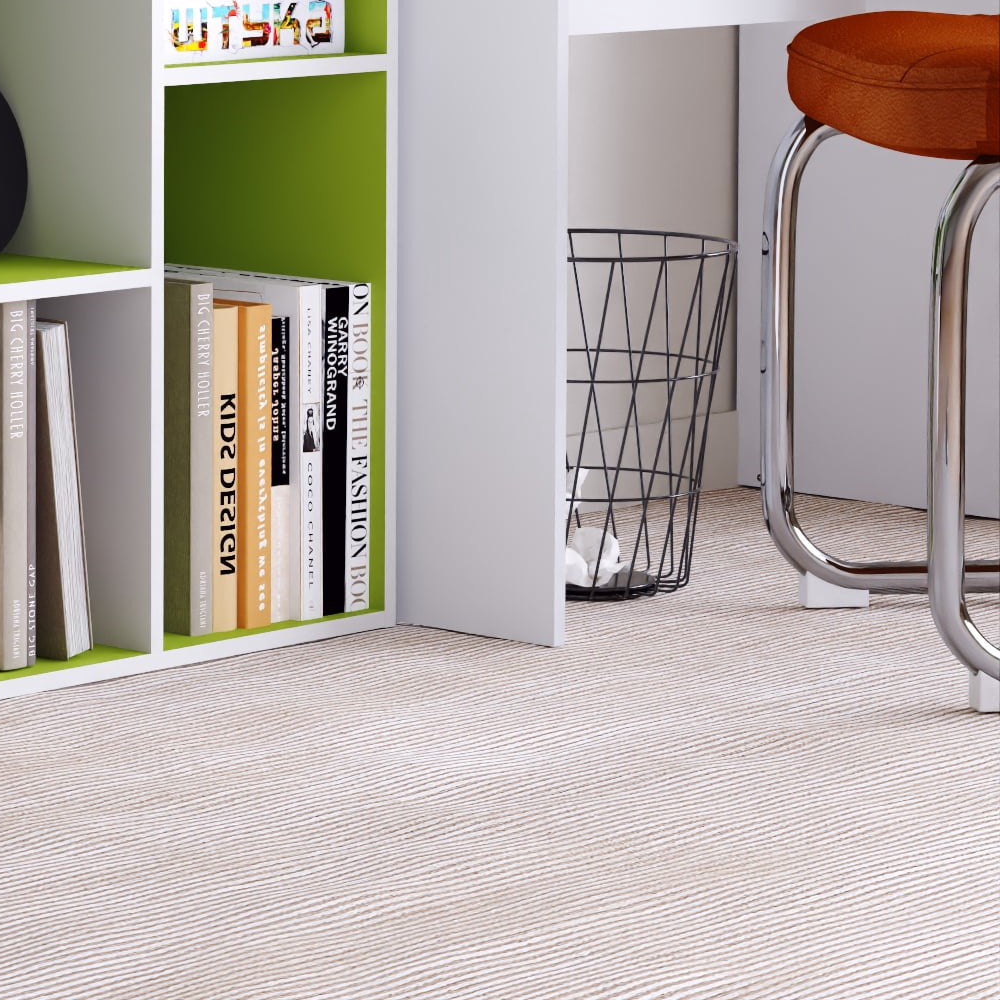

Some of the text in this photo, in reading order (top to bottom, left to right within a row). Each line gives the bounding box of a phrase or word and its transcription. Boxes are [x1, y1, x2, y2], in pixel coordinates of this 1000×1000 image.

[10, 310, 24, 440] BIG CHERRY HOLLER
[197, 293, 211, 418] BIG CHERRY HOLLER
[326, 316, 338, 431] WINOGRAND
[337, 316, 348, 378] GARRY
[352, 323, 369, 390] BOOK
[351, 398, 368, 450] THE
[350, 456, 368, 559] FASHION
[28, 563, 36, 656] BIG STONE GAP
